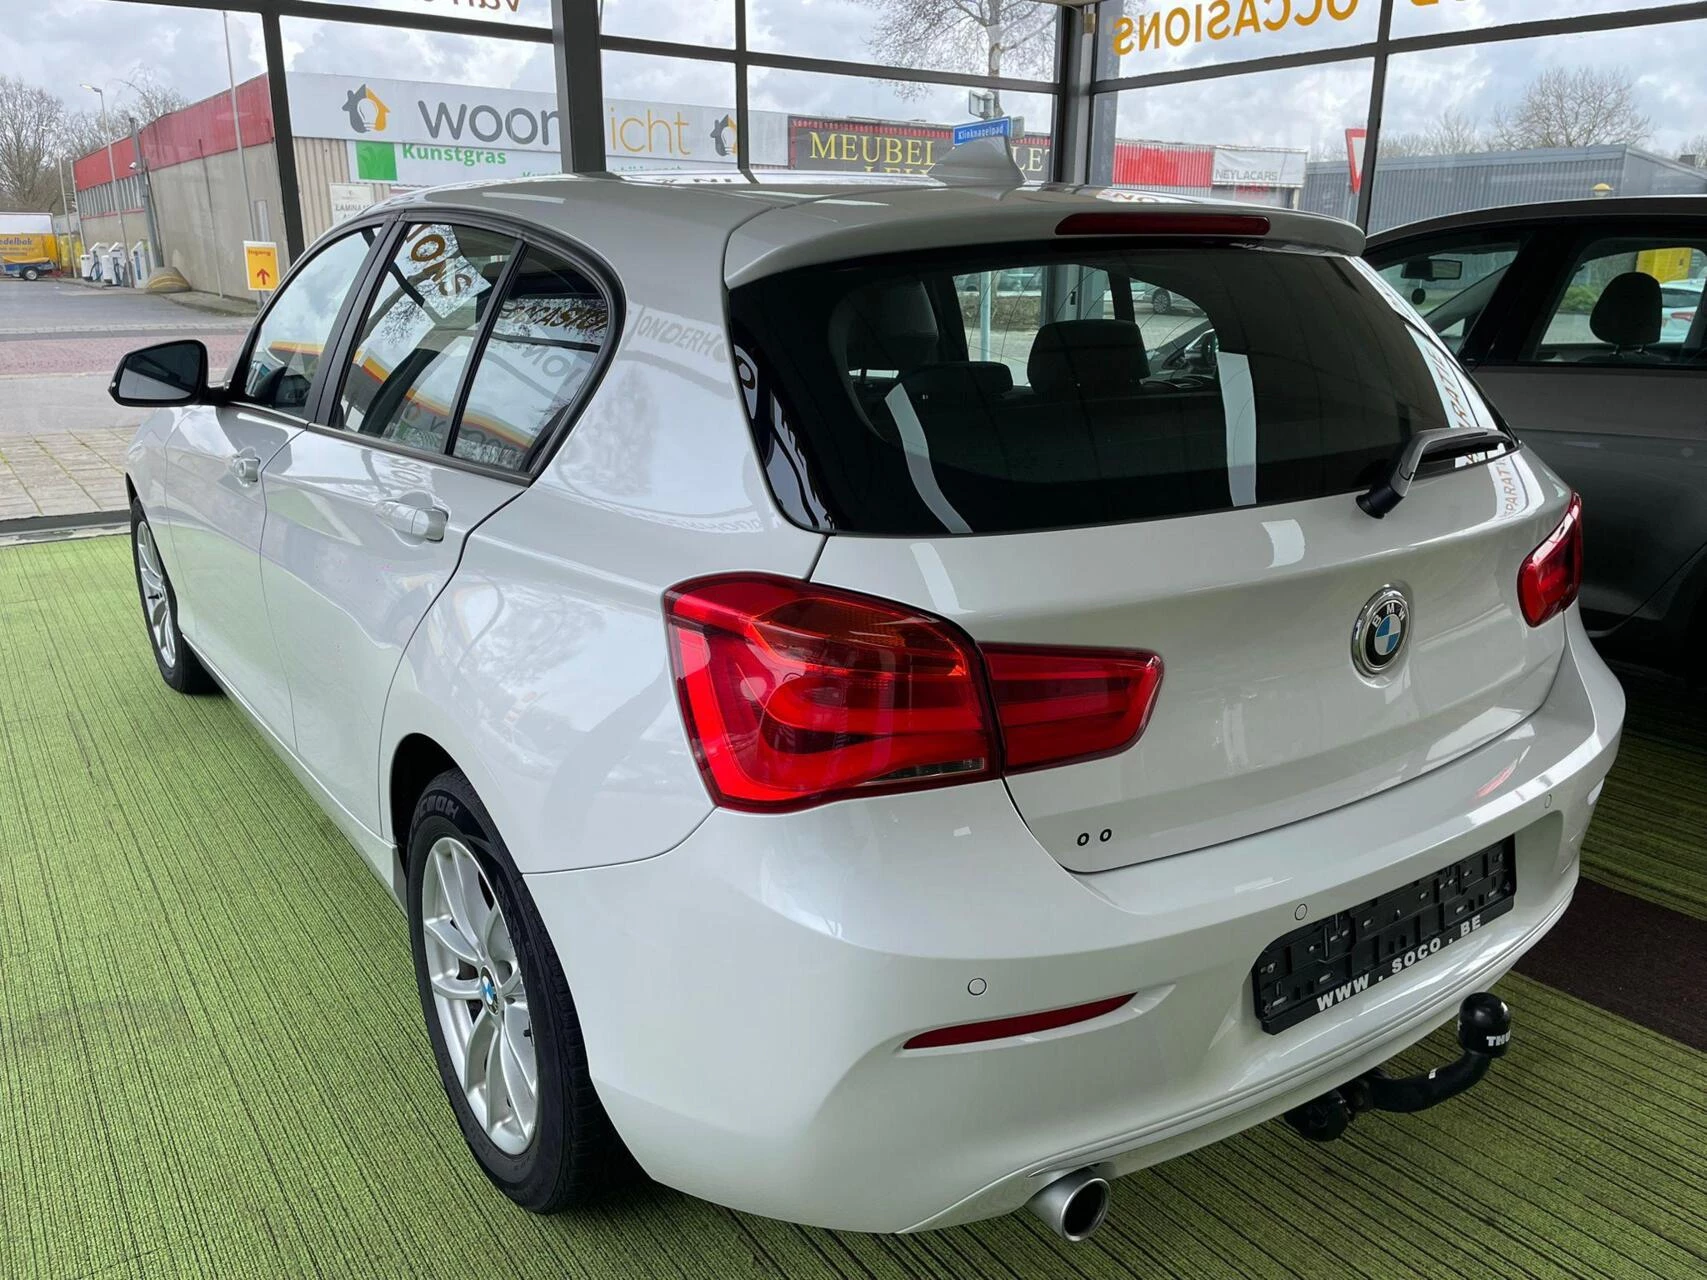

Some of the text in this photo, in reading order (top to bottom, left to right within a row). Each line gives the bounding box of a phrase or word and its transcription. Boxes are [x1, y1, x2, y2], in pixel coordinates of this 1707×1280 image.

[402, 143, 507, 167] Kunstgras
[1215, 169, 1278, 180] NEYLACARS
[1371, 602, 1406, 628] BMW
